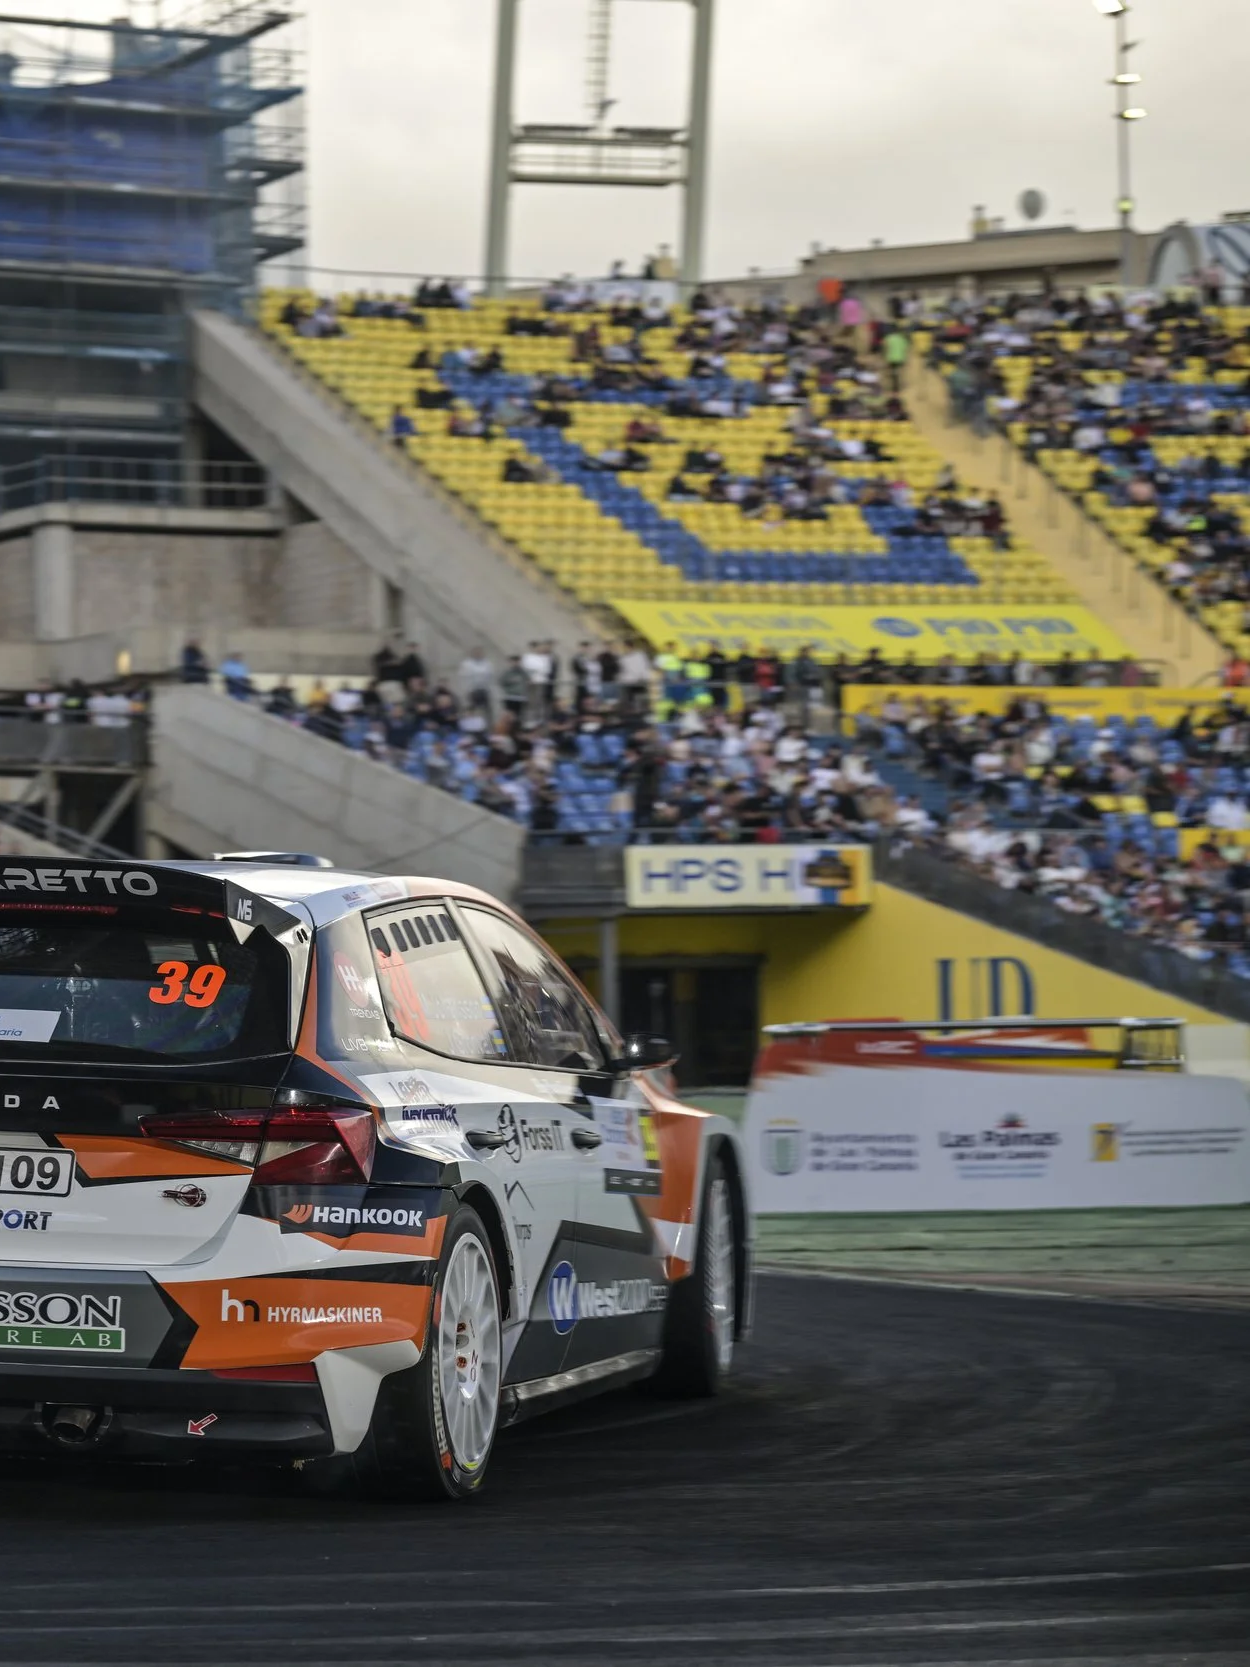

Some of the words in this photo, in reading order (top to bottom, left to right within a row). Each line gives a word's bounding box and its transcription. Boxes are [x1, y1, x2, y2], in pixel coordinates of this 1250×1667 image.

[641, 858, 743, 893] HPS
[148, 960, 227, 1008] 39
[267, 1305, 383, 1324] HYRMASKINER
[70, 1328, 112, 1347] AB
